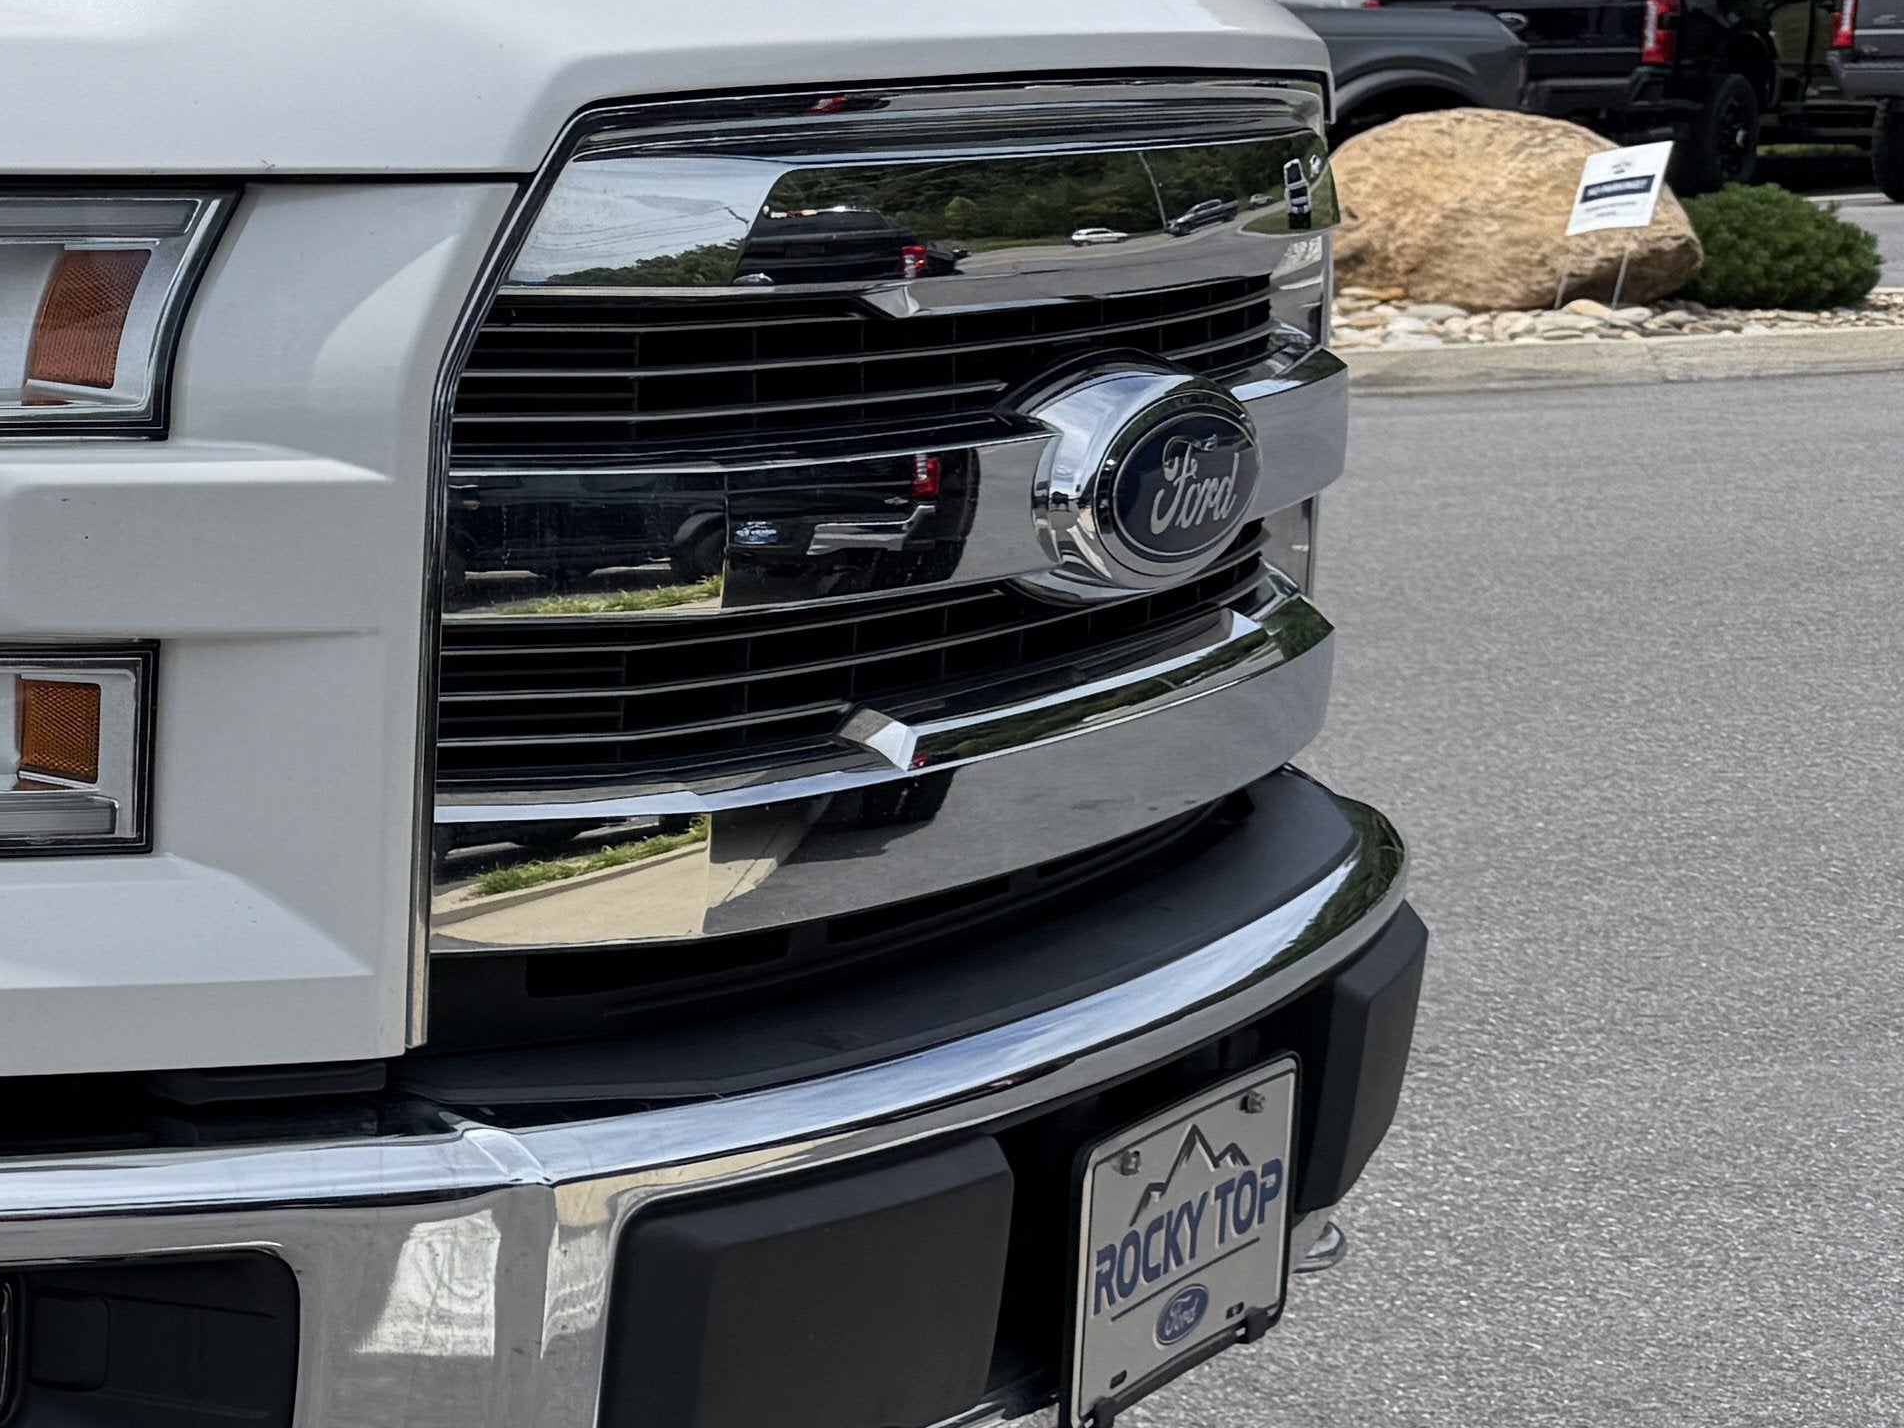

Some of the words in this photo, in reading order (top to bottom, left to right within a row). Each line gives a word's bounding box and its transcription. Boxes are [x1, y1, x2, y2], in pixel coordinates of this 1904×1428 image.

[1150, 434, 1240, 535] Ford
[1094, 1190, 1209, 1316] ROCKY
[1214, 1157, 1283, 1249] TOP
